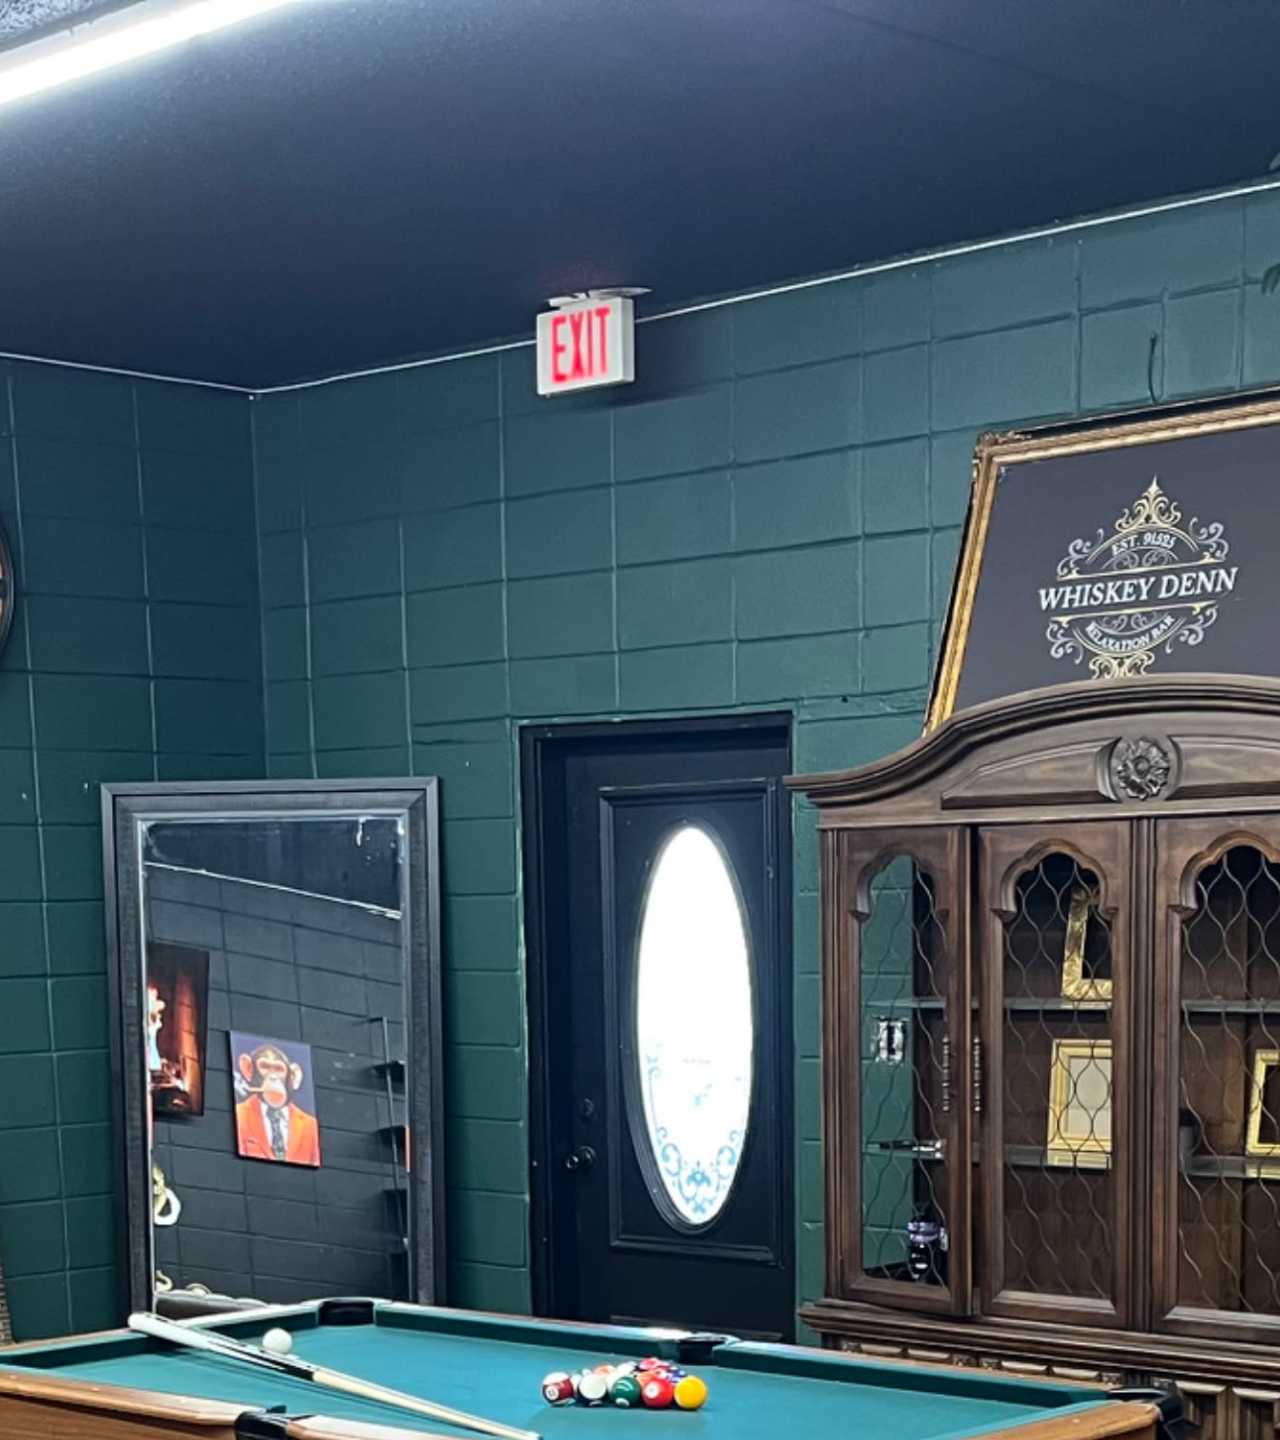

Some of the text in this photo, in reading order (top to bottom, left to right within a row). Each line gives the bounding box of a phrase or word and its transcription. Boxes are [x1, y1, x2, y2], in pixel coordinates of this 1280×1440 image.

[550, 304, 611, 384] EXIT
[1038, 567, 1239, 611] WHISKEY DENN
[1085, 615, 1175, 652] RELAXATION BAR
